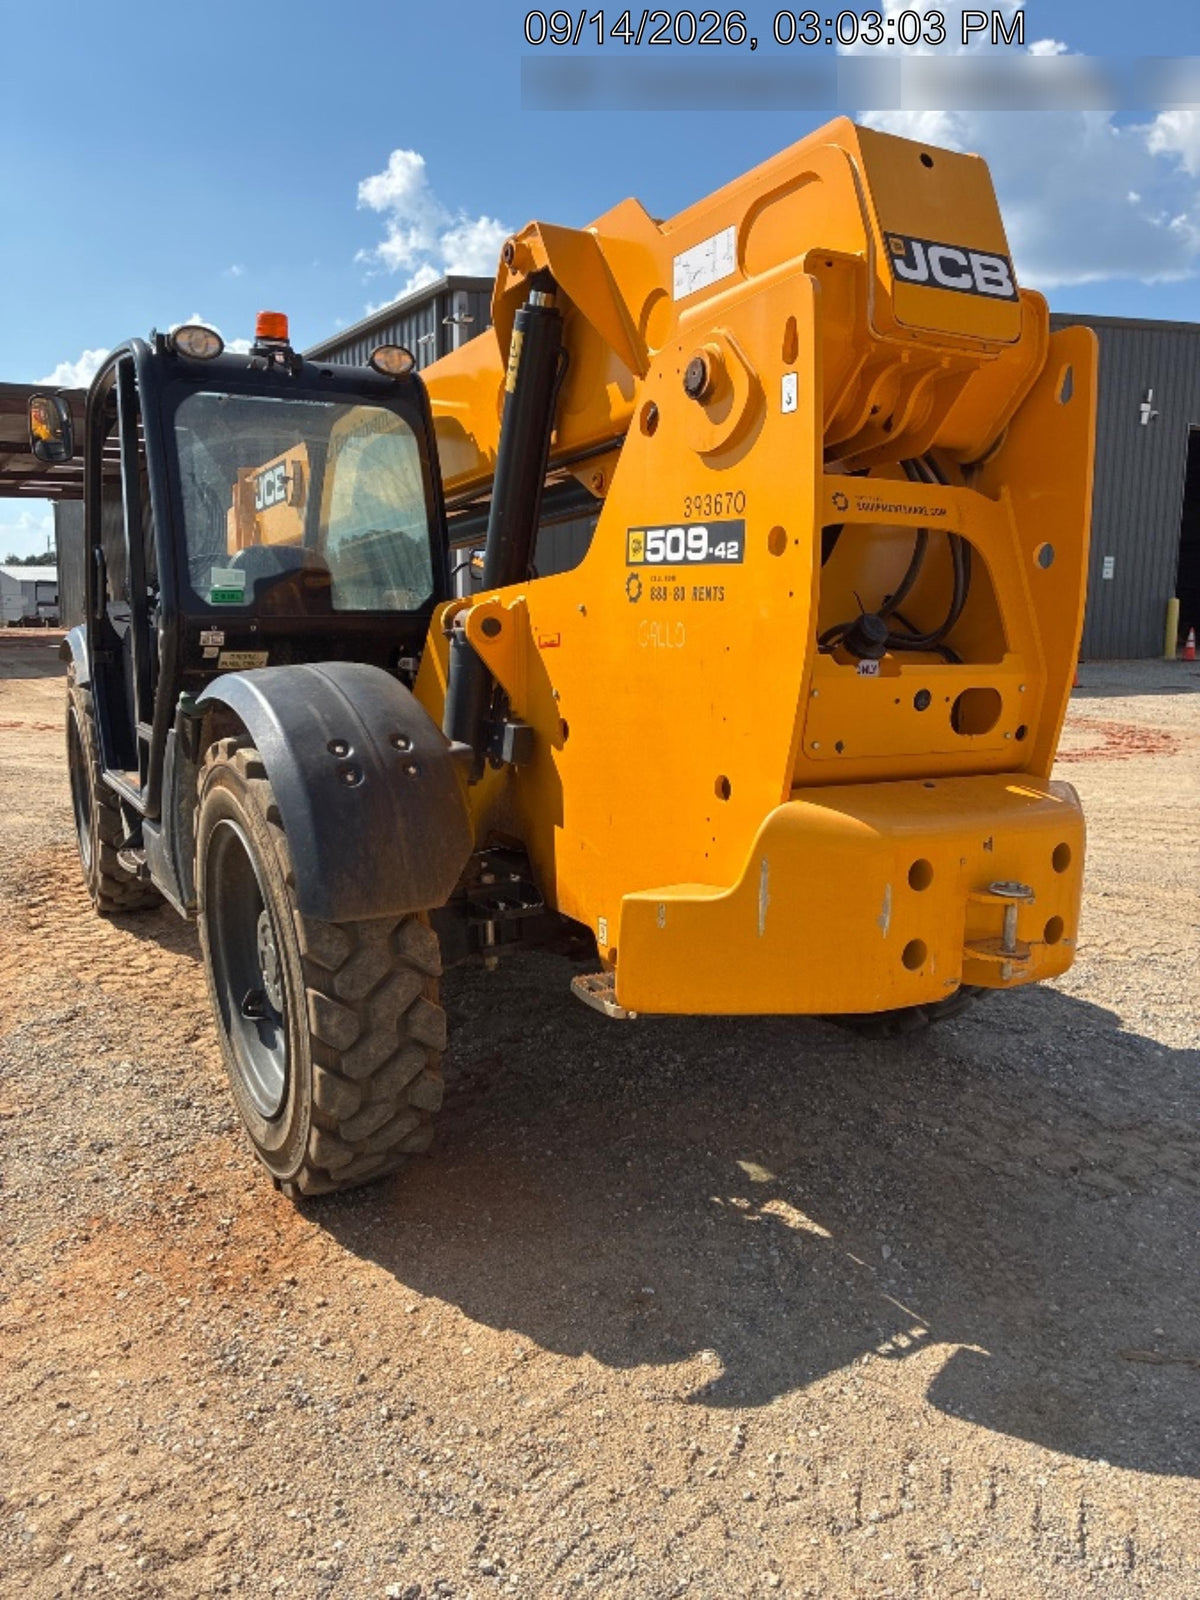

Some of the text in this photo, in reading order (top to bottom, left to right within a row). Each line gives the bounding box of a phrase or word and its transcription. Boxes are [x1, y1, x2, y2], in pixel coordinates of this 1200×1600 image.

[894, 241, 1015, 297] JCB
[255, 465, 286, 511] JCB
[684, 490, 746, 518] 393670
[692, 585, 725, 602] RENTS
